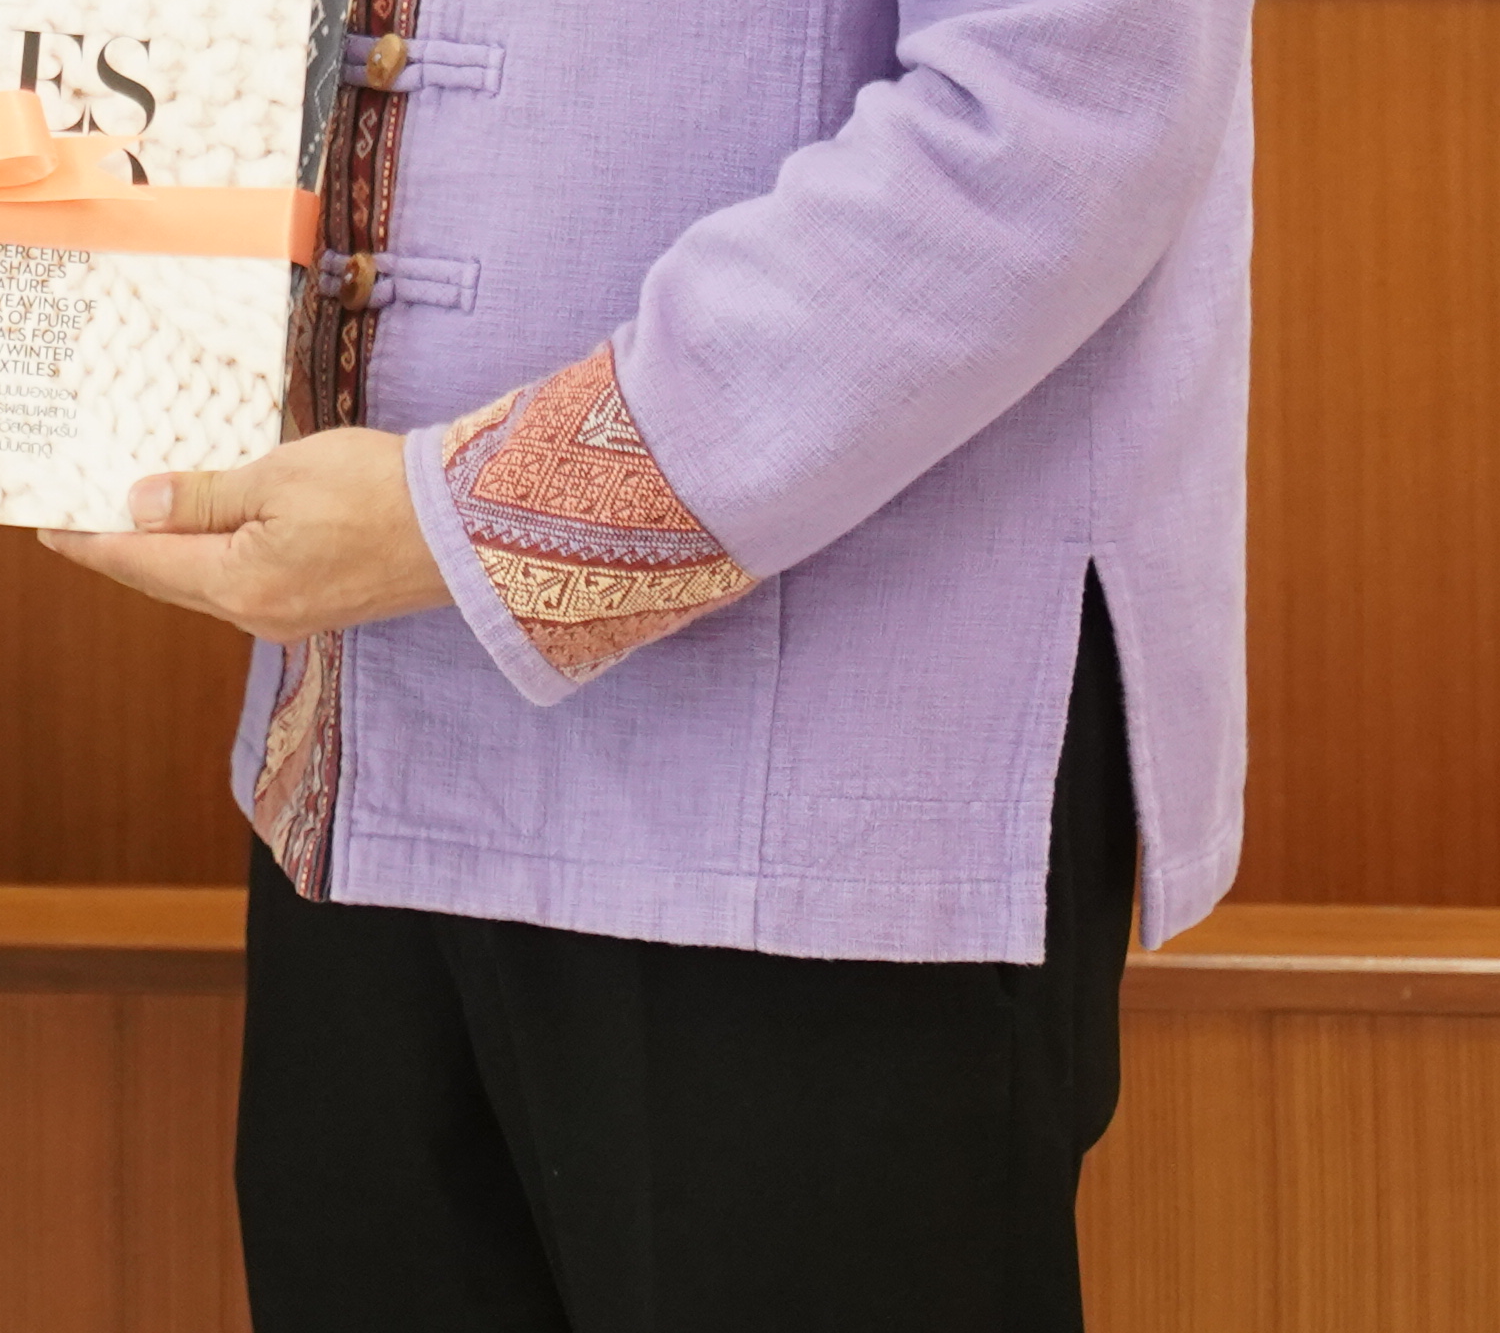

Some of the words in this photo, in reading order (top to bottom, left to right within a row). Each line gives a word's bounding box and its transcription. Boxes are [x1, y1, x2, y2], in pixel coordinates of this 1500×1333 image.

[0, 259, 67, 279] SHADES
[74, 298, 98, 314] OF
[8, 310, 33, 325] OF
[38, 313, 82, 330] PURE
[32, 329, 67, 345] FOR
